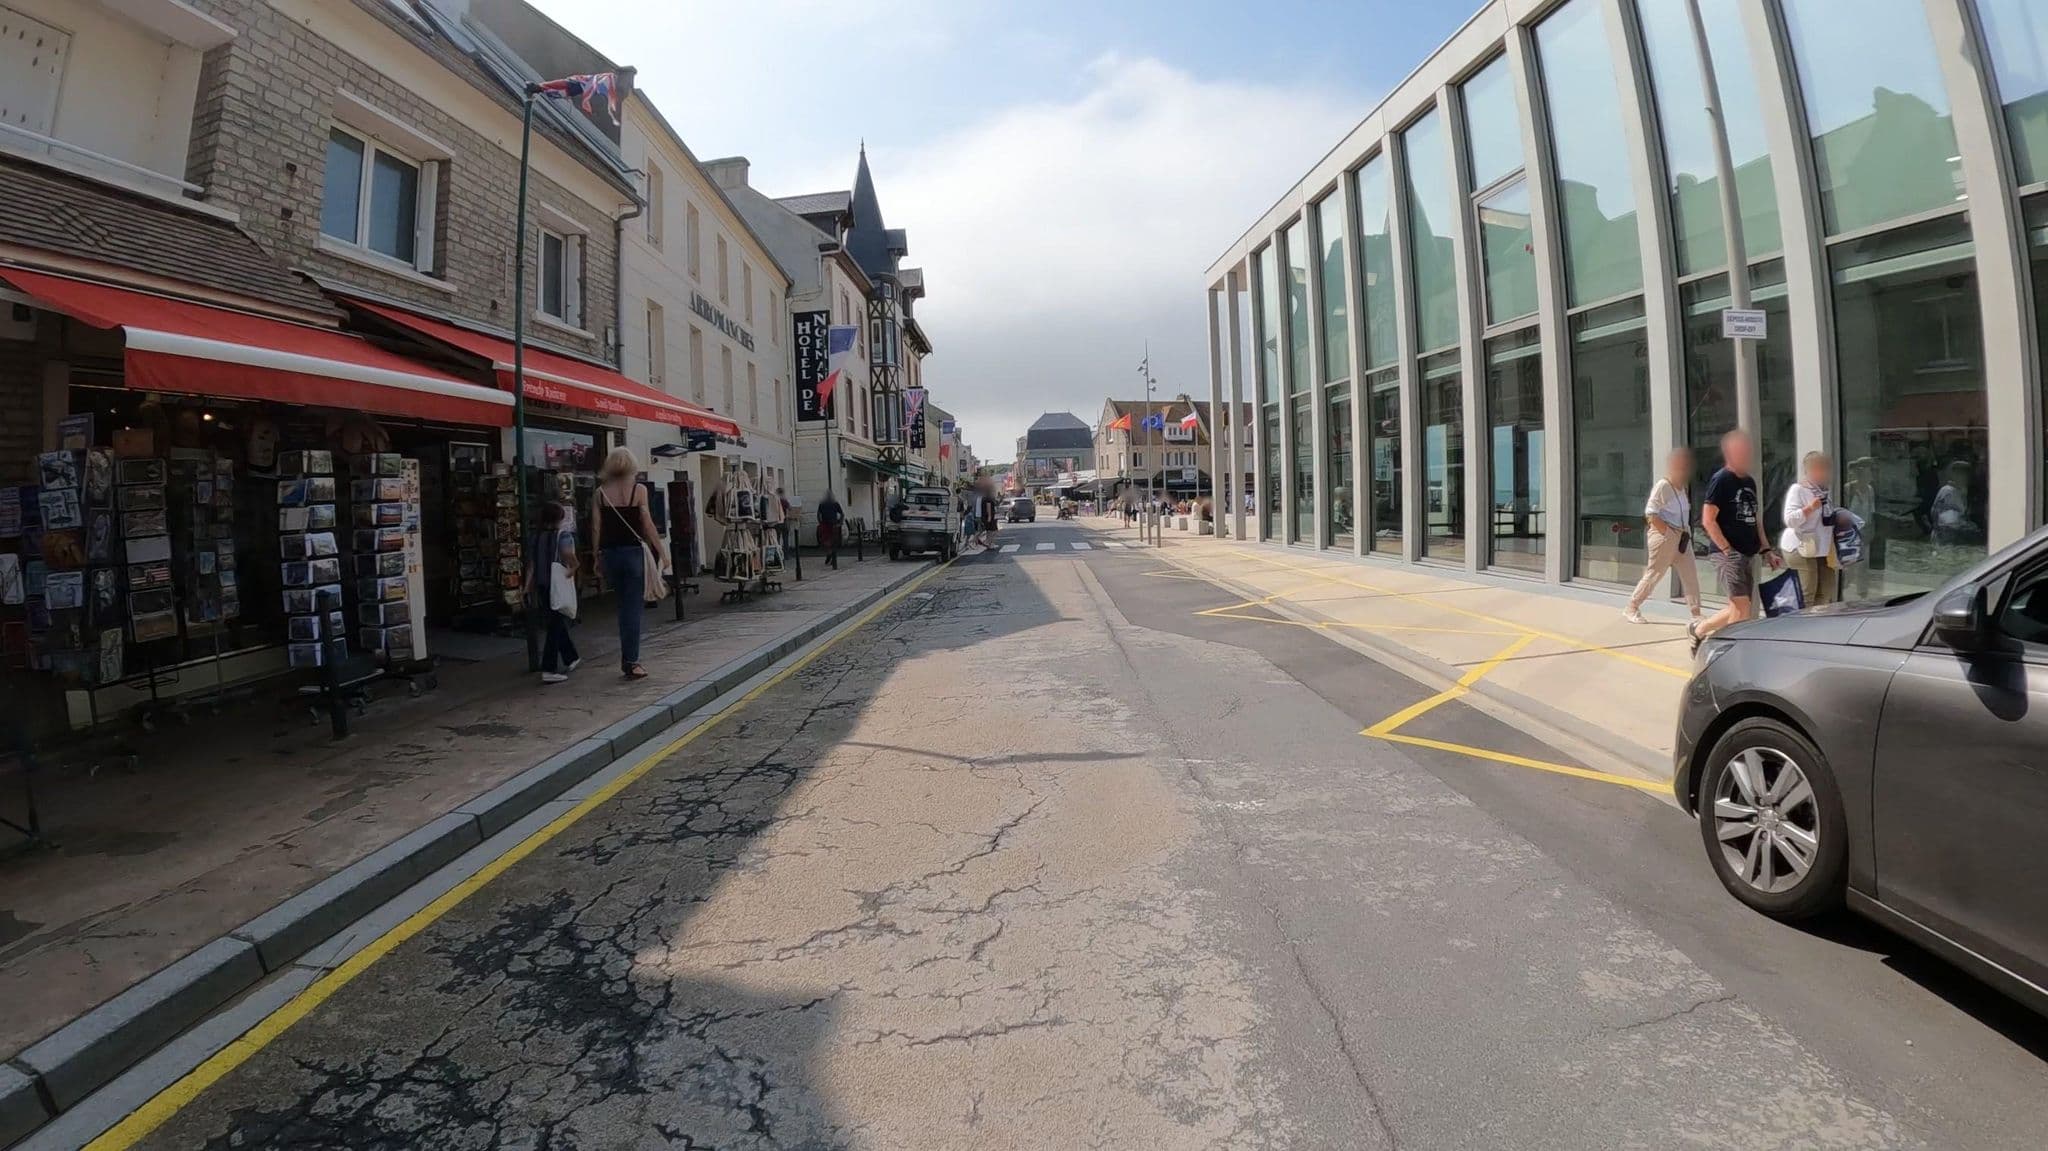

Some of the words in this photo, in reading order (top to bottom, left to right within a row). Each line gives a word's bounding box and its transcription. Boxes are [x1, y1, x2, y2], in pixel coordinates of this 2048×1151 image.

[687, 289, 755, 353] ARROMANCHES
[797, 321, 811, 380] HOTEL
[802, 388, 814, 411] DE
